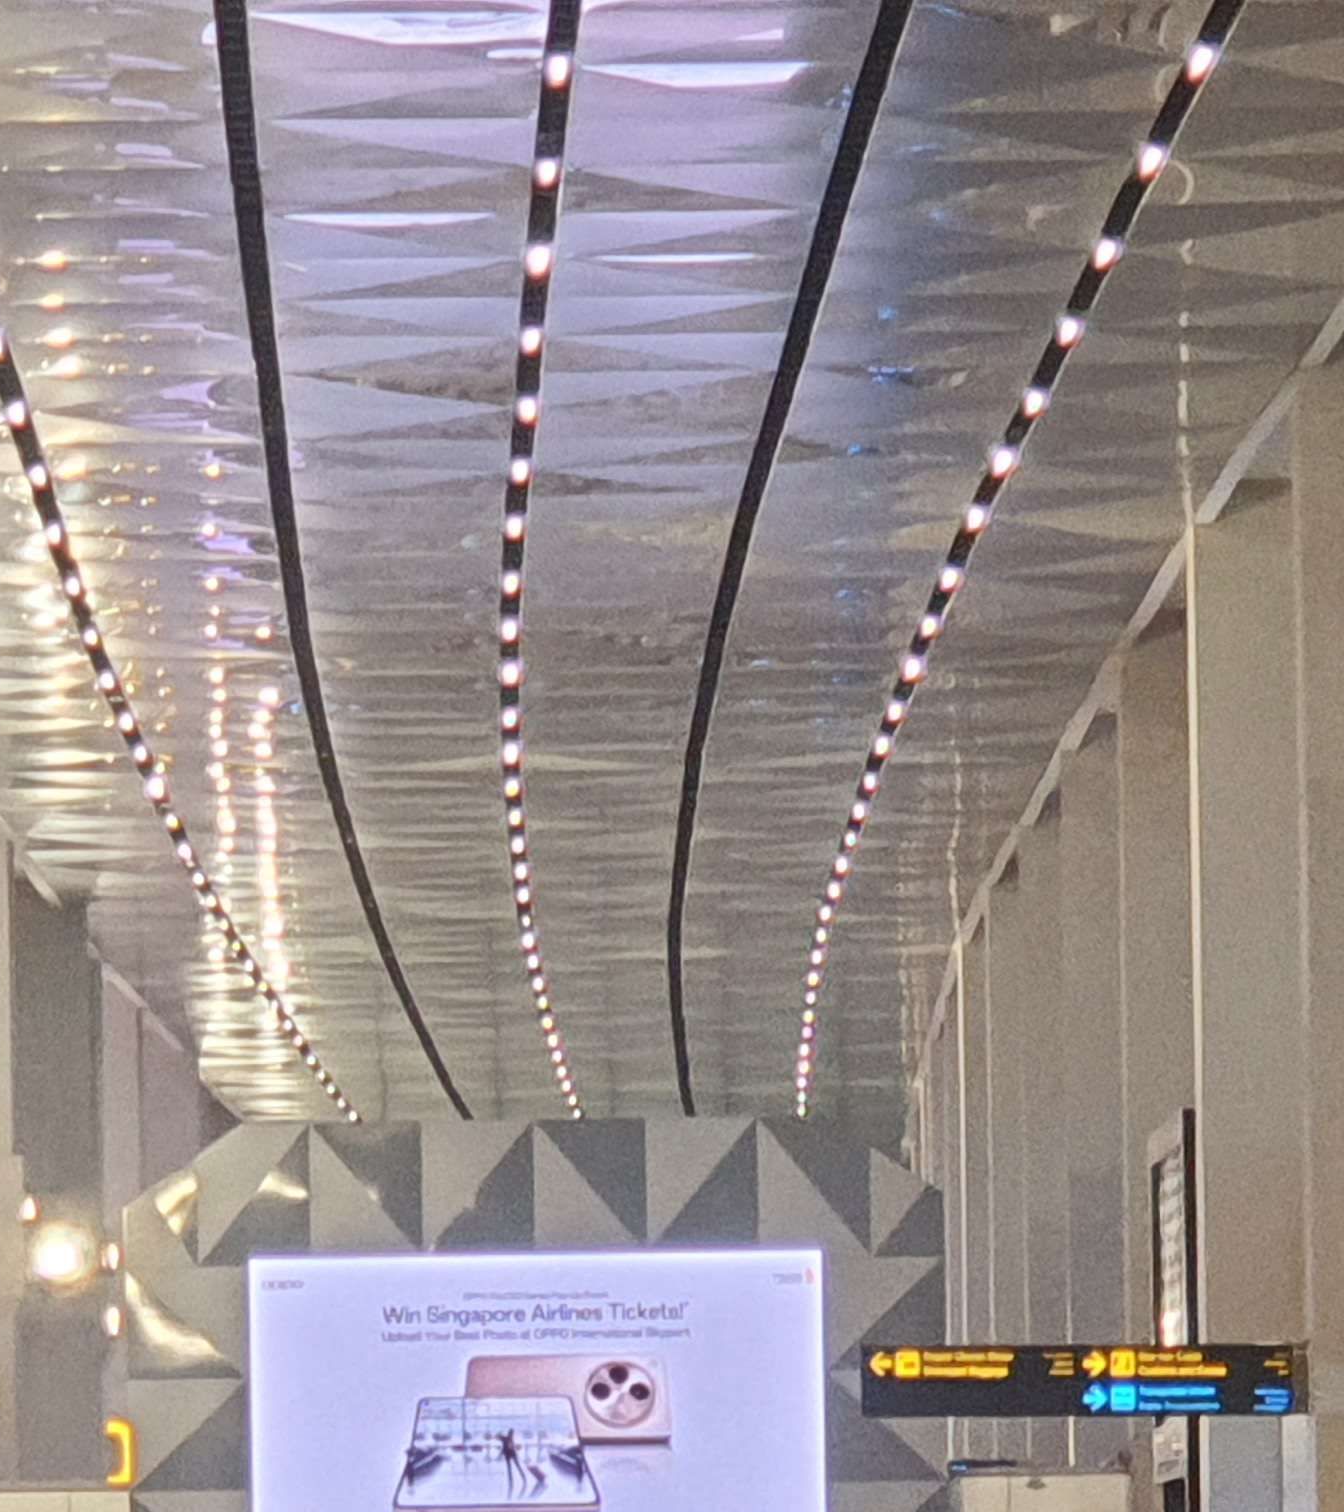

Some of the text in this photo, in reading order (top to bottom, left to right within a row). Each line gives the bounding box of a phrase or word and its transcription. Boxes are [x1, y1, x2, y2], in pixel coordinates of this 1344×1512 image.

[382, 1305, 421, 1324] Win
[427, 1304, 526, 1327] Singapore
[531, 1303, 603, 1322] Airlines
